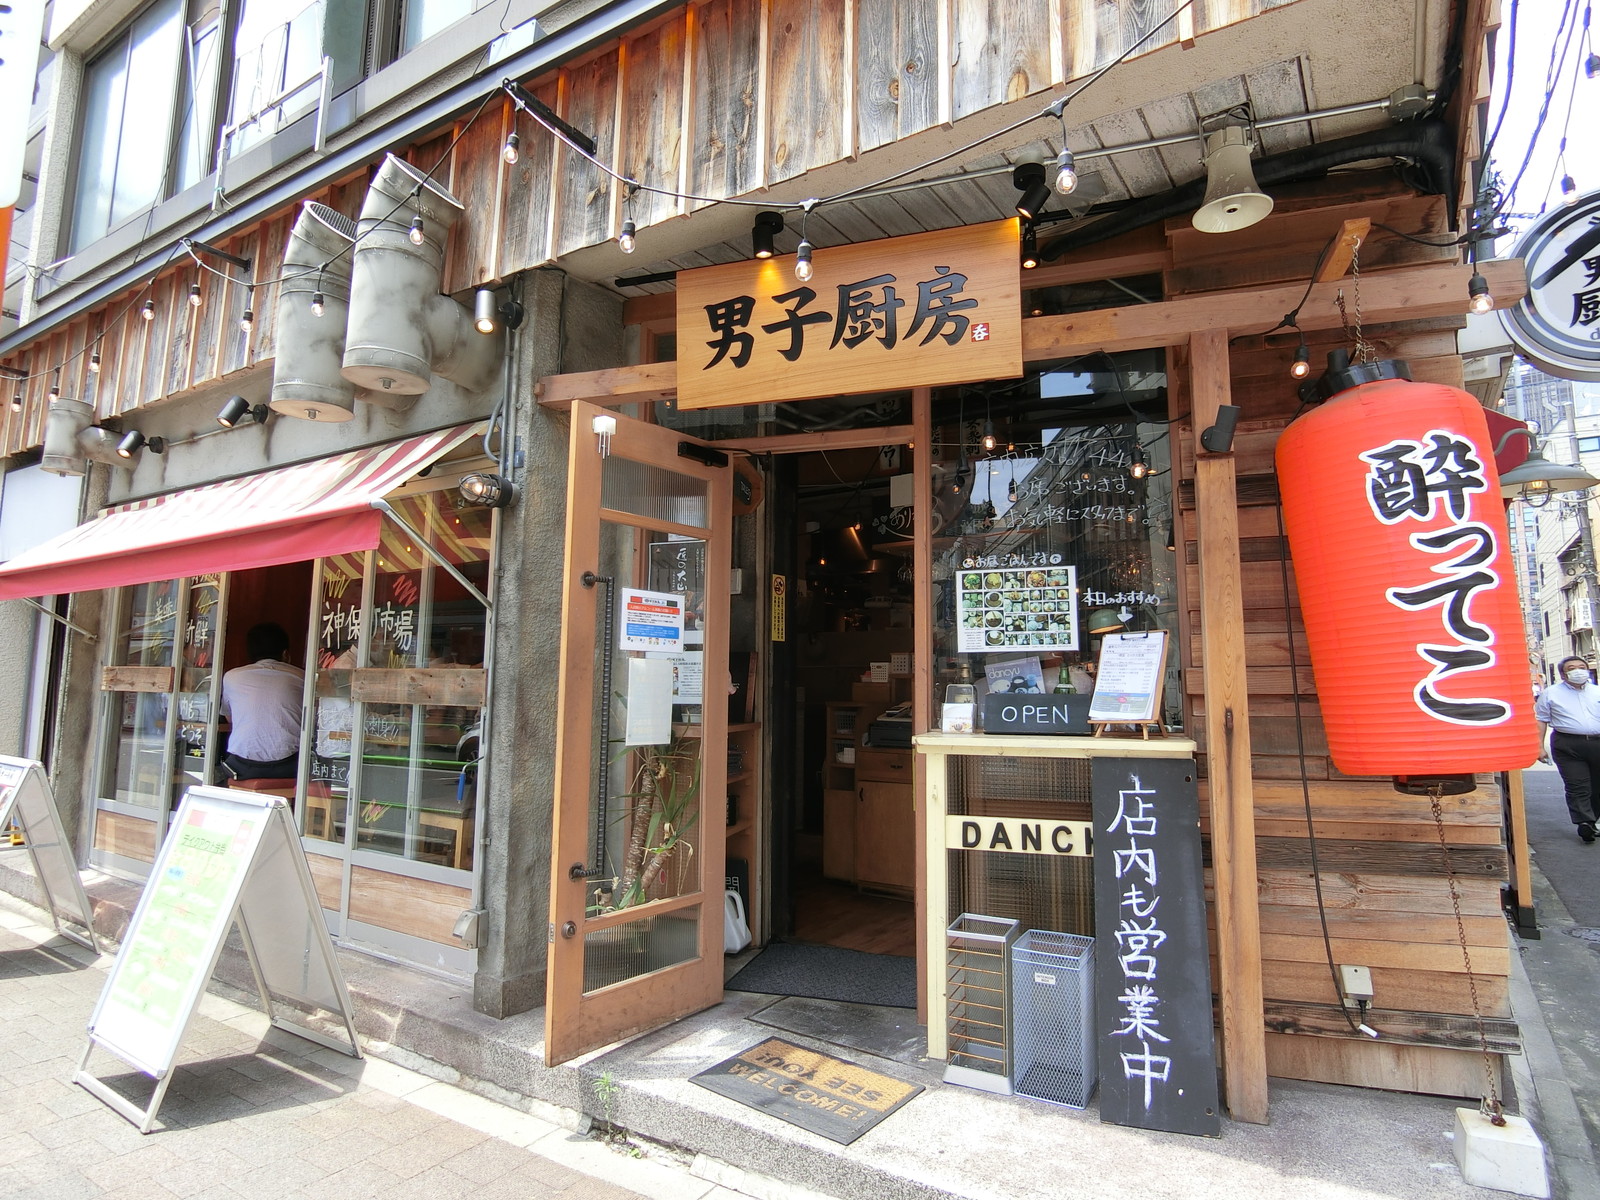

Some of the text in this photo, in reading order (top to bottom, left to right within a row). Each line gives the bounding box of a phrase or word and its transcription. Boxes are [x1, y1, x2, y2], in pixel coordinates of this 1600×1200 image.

[703, 266, 978, 370] 男子厨房
[1081, 587, 1161, 607] 本日のおすすめ
[1359, 429, 1513, 726] 酔ってこ
[1001, 704, 1069, 724] OPEN
[1106, 773, 1171, 1109] 店内も営業中
[727, 1062, 867, 1121] WELCOME!
[824, 1076, 882, 1102] SEE
